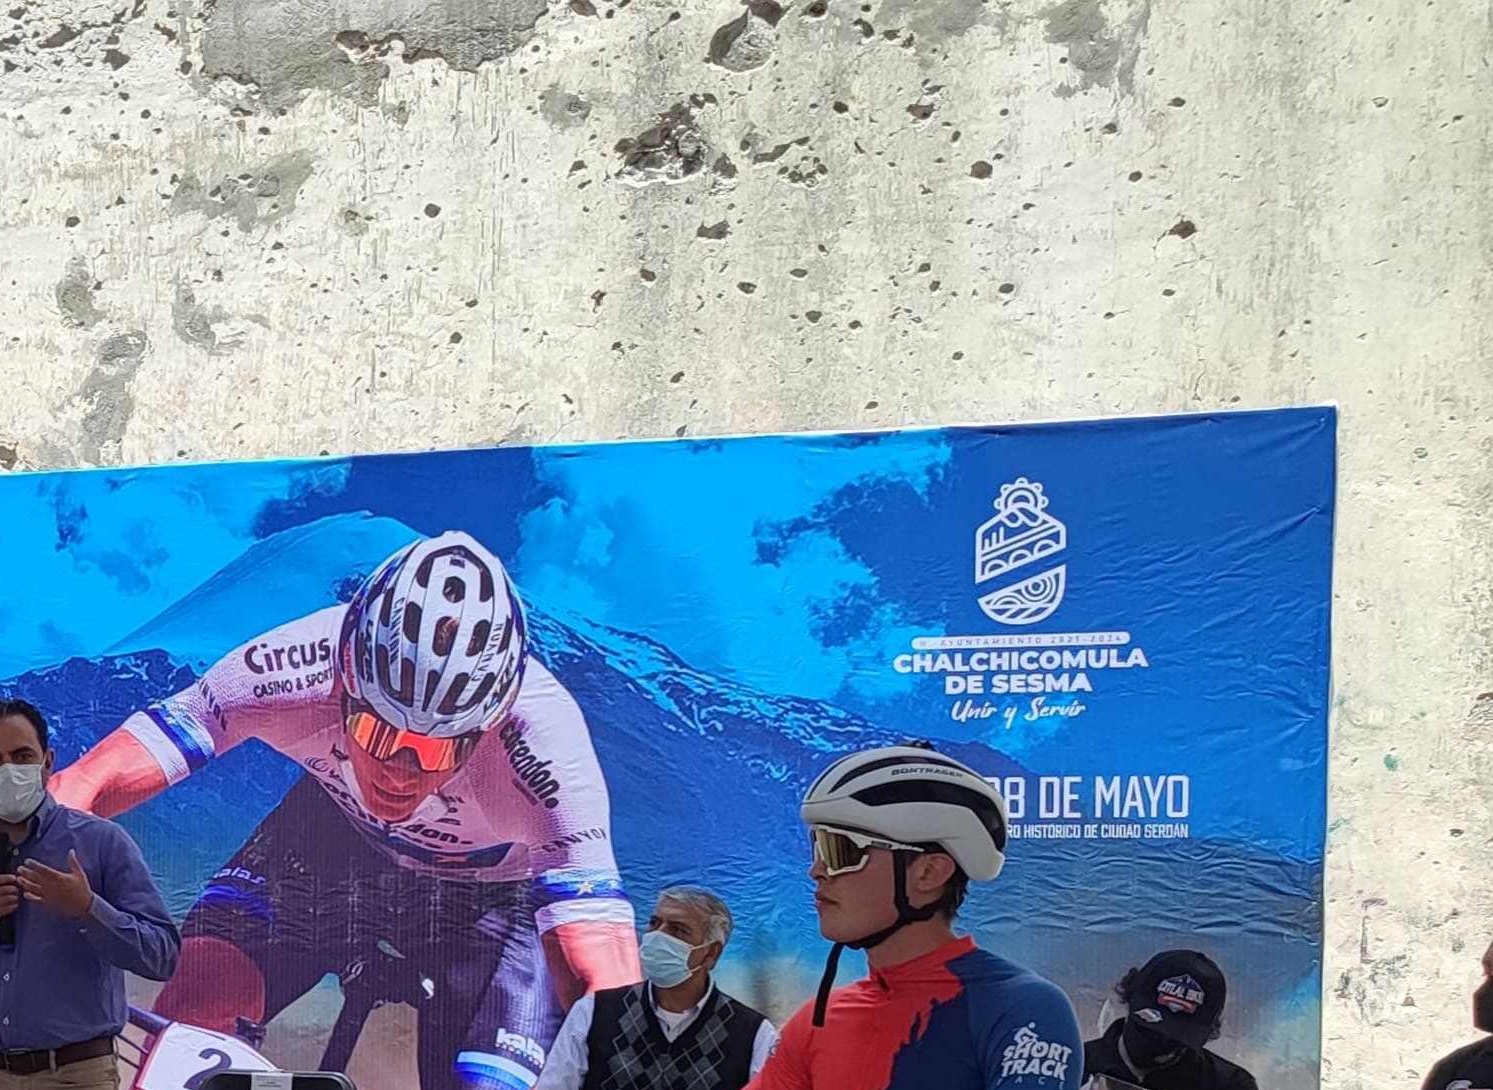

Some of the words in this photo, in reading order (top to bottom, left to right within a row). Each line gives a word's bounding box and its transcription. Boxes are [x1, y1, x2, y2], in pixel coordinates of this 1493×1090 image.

[939, 636, 1044, 647] AYUNTAMIENTO
[1050, 634, 1123, 645] 2021-2024
[244, 638, 331, 675] Circus
[893, 648, 1150, 674] CHALCHICOMULA
[252, 678, 294, 698] CASINO
[295, 676, 305, 691] &
[944, 675, 984, 695] DE
[990, 672, 1094, 694] SESMA
[951, 699, 997, 723] Unir
[1003, 706, 1018, 729] y
[1023, 695, 1087, 722] Servir
[1038, 776, 1083, 819] DE
[1094, 775, 1190, 819] MAYO
[1083, 825, 1099, 839] DE
[1100, 824, 1142, 839] CIUDAD
[1143, 822, 1189, 838] SERDÁN
[1002, 1040, 1073, 1064] SHORT
[1001, 1058, 1068, 1081] TRACK
